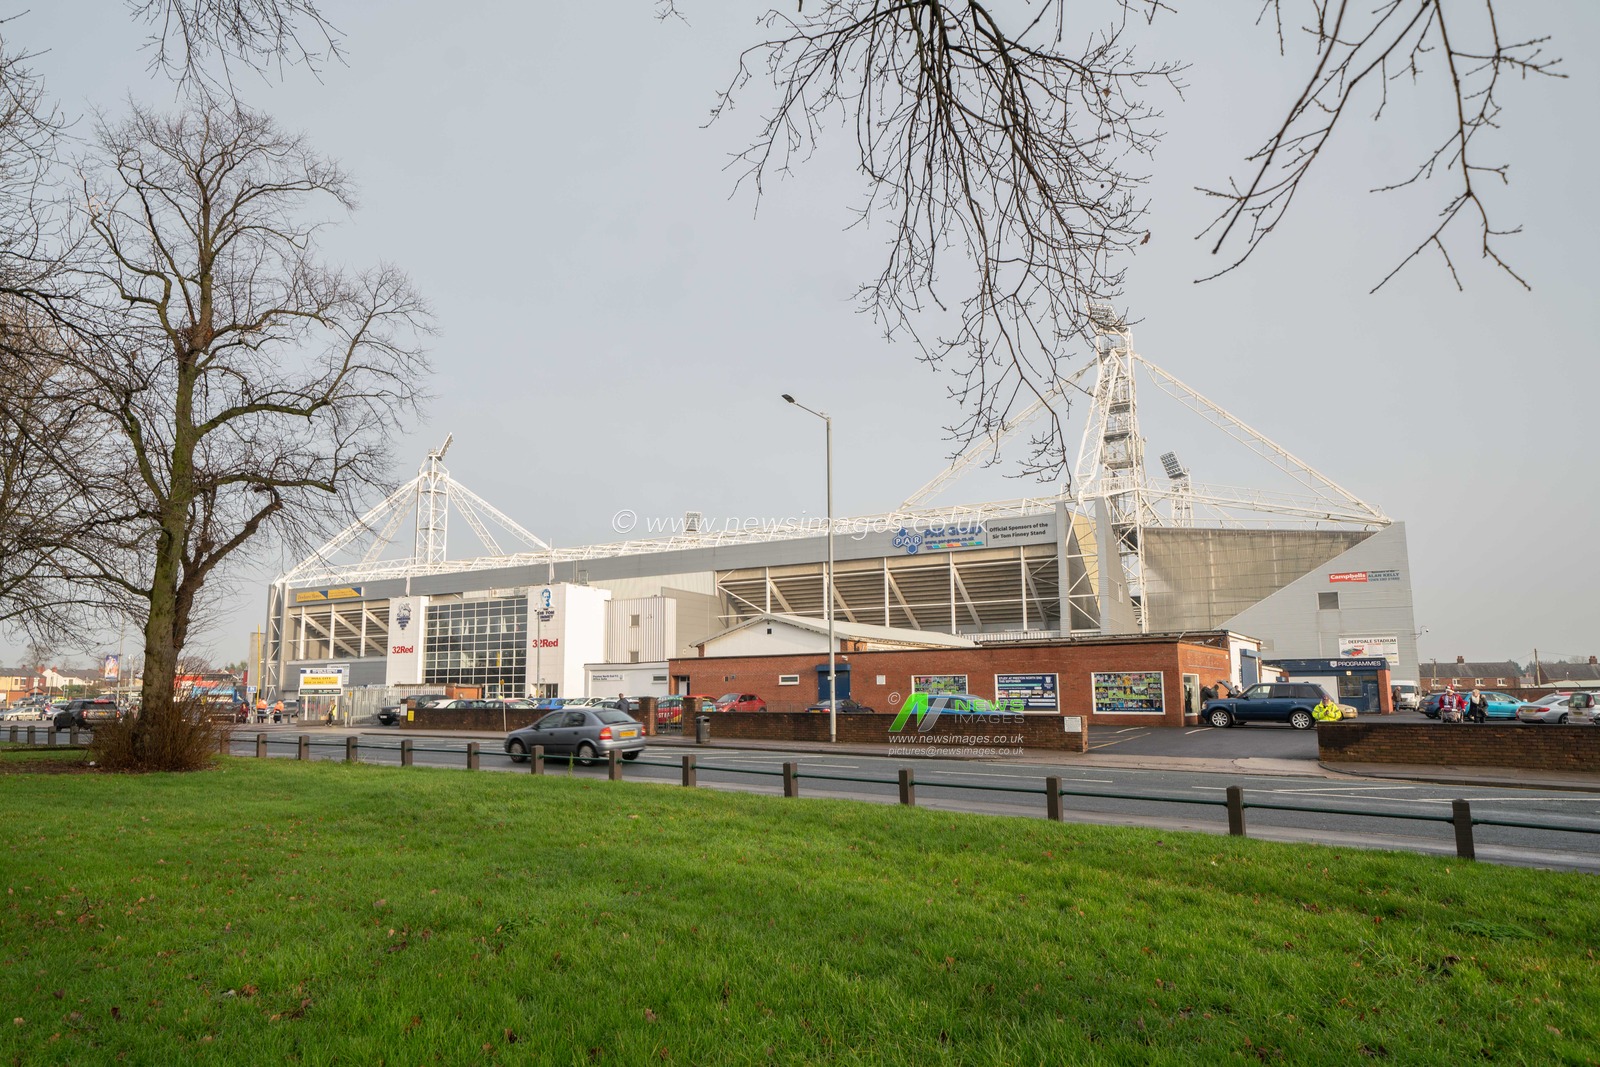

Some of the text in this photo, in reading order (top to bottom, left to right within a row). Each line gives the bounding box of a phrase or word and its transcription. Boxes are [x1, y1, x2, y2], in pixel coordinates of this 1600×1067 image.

[989, 525, 1008, 533] Official
[1008, 523, 1032, 532] Sponsors
[1012, 531, 1029, 539] Finney
[894, 536, 921, 545] PAR
[1330, 572, 1366, 580] Campbells
[532, 638, 559, 648] 32Red
[392, 645, 414, 654] 32Red
